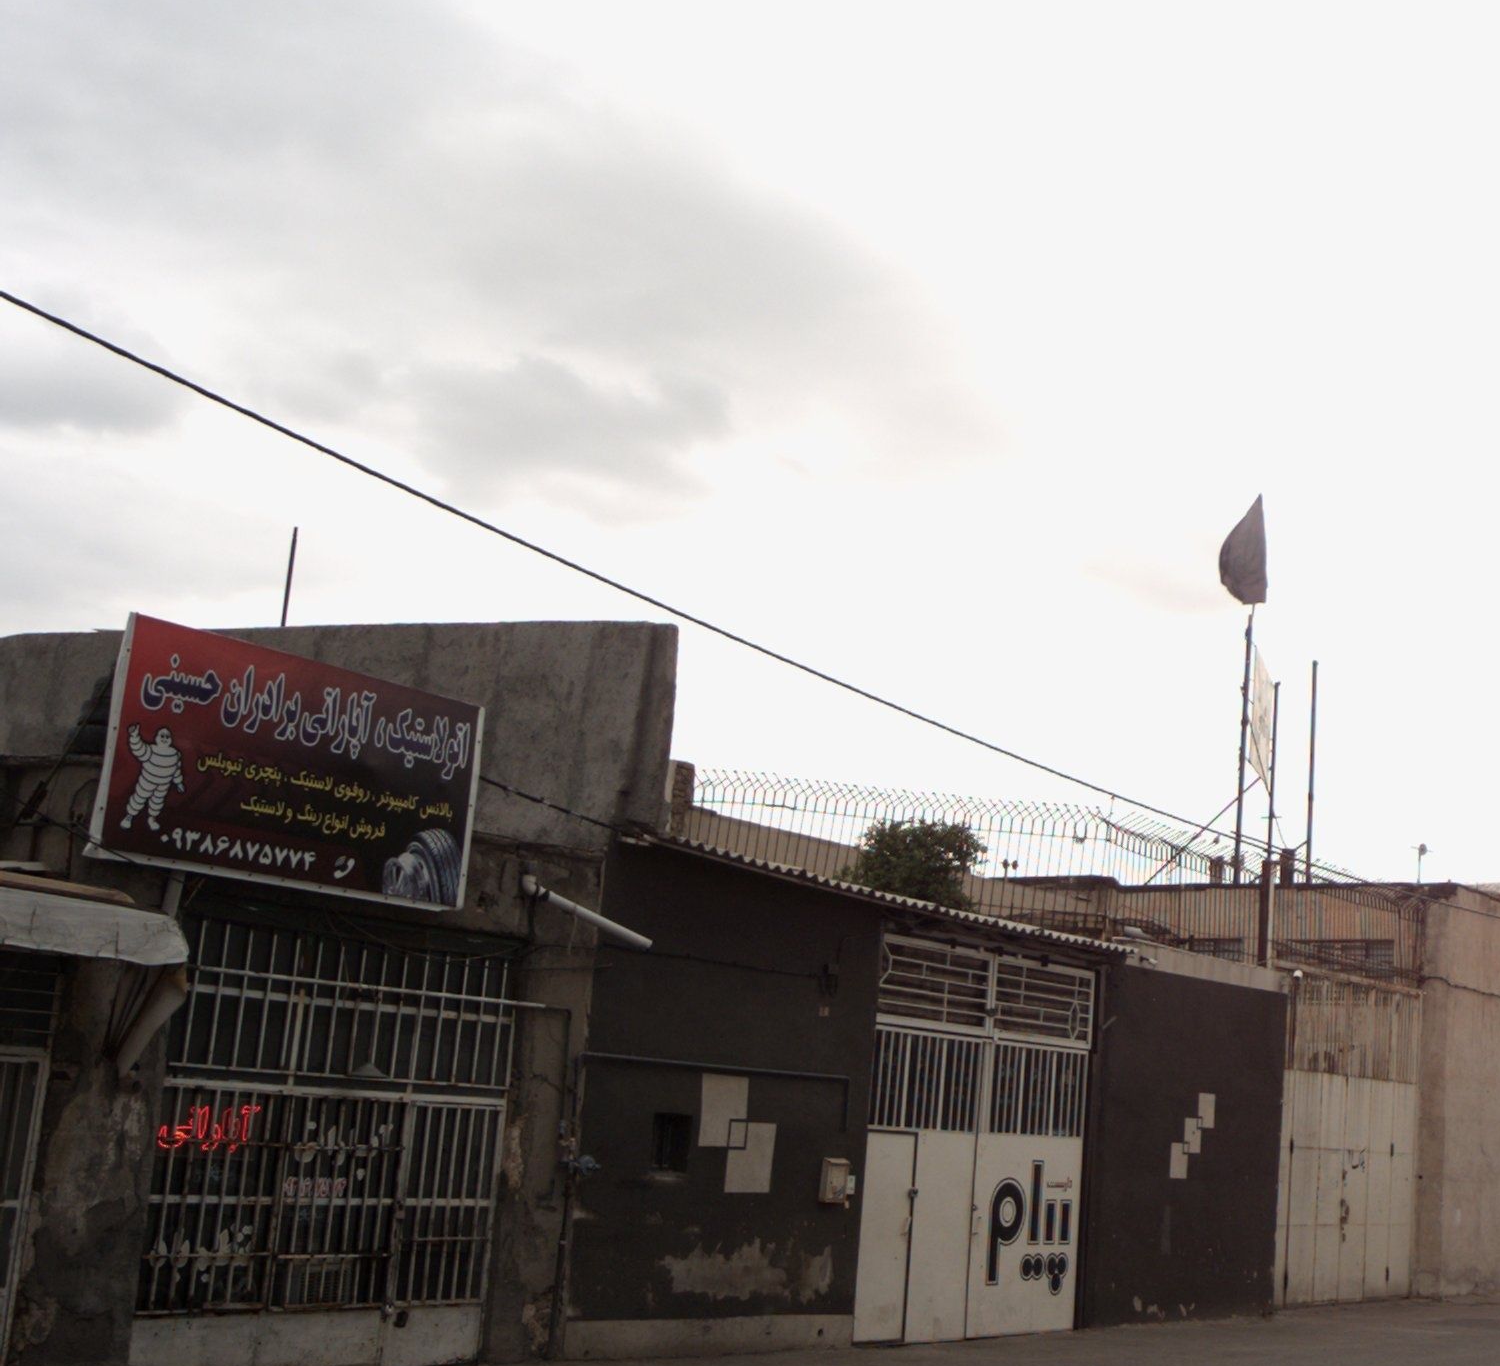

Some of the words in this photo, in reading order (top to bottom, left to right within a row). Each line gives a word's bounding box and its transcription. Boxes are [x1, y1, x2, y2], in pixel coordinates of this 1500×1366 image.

[141, 654, 222, 713] حسینی
[221, 665, 300, 740] برادران
[197, 752, 242, 777] تیوبلس
[244, 762, 282, 788] پنچری
[240, 795, 285, 817] لاستیک
[419, 800, 454, 822] بالانس
[321, 813, 349, 835] انواع
[350, 817, 386, 840] فروش
[160, 826, 317, 872] ۰۹۳۸۶۸۷۵۷۷۴
